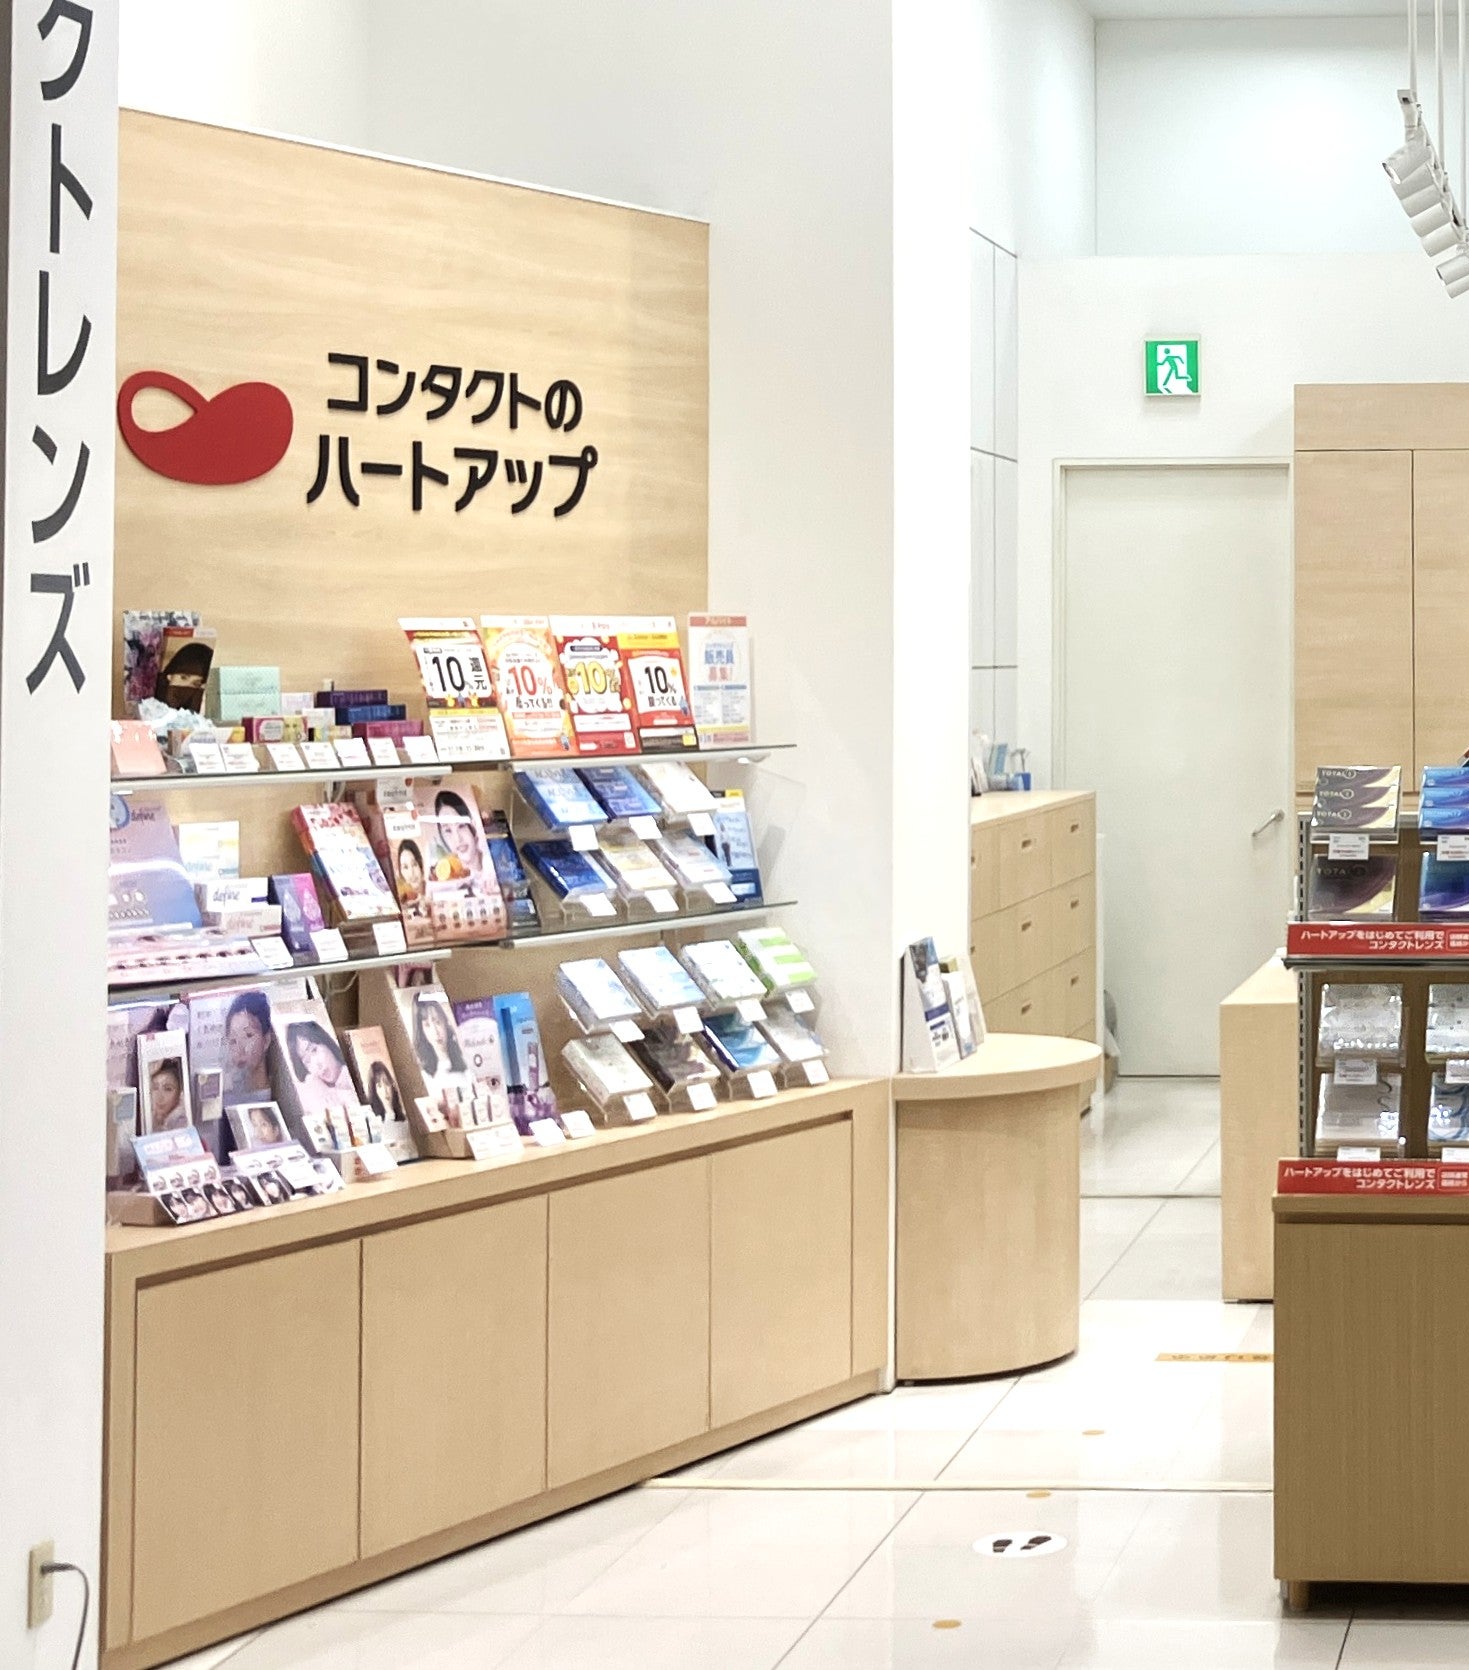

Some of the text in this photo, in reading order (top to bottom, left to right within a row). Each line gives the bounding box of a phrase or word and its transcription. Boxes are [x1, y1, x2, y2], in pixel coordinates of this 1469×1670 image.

[327, 352, 583, 433] コンタクトの
[305, 434, 599, 518] ハートアップ
[1301, 929, 1444, 940] ハートアップをはじめてご利用で
[1369, 940, 1444, 950] コンタクトレンズ
[1356, 1178, 1435, 1189] コンタクトレンズ
